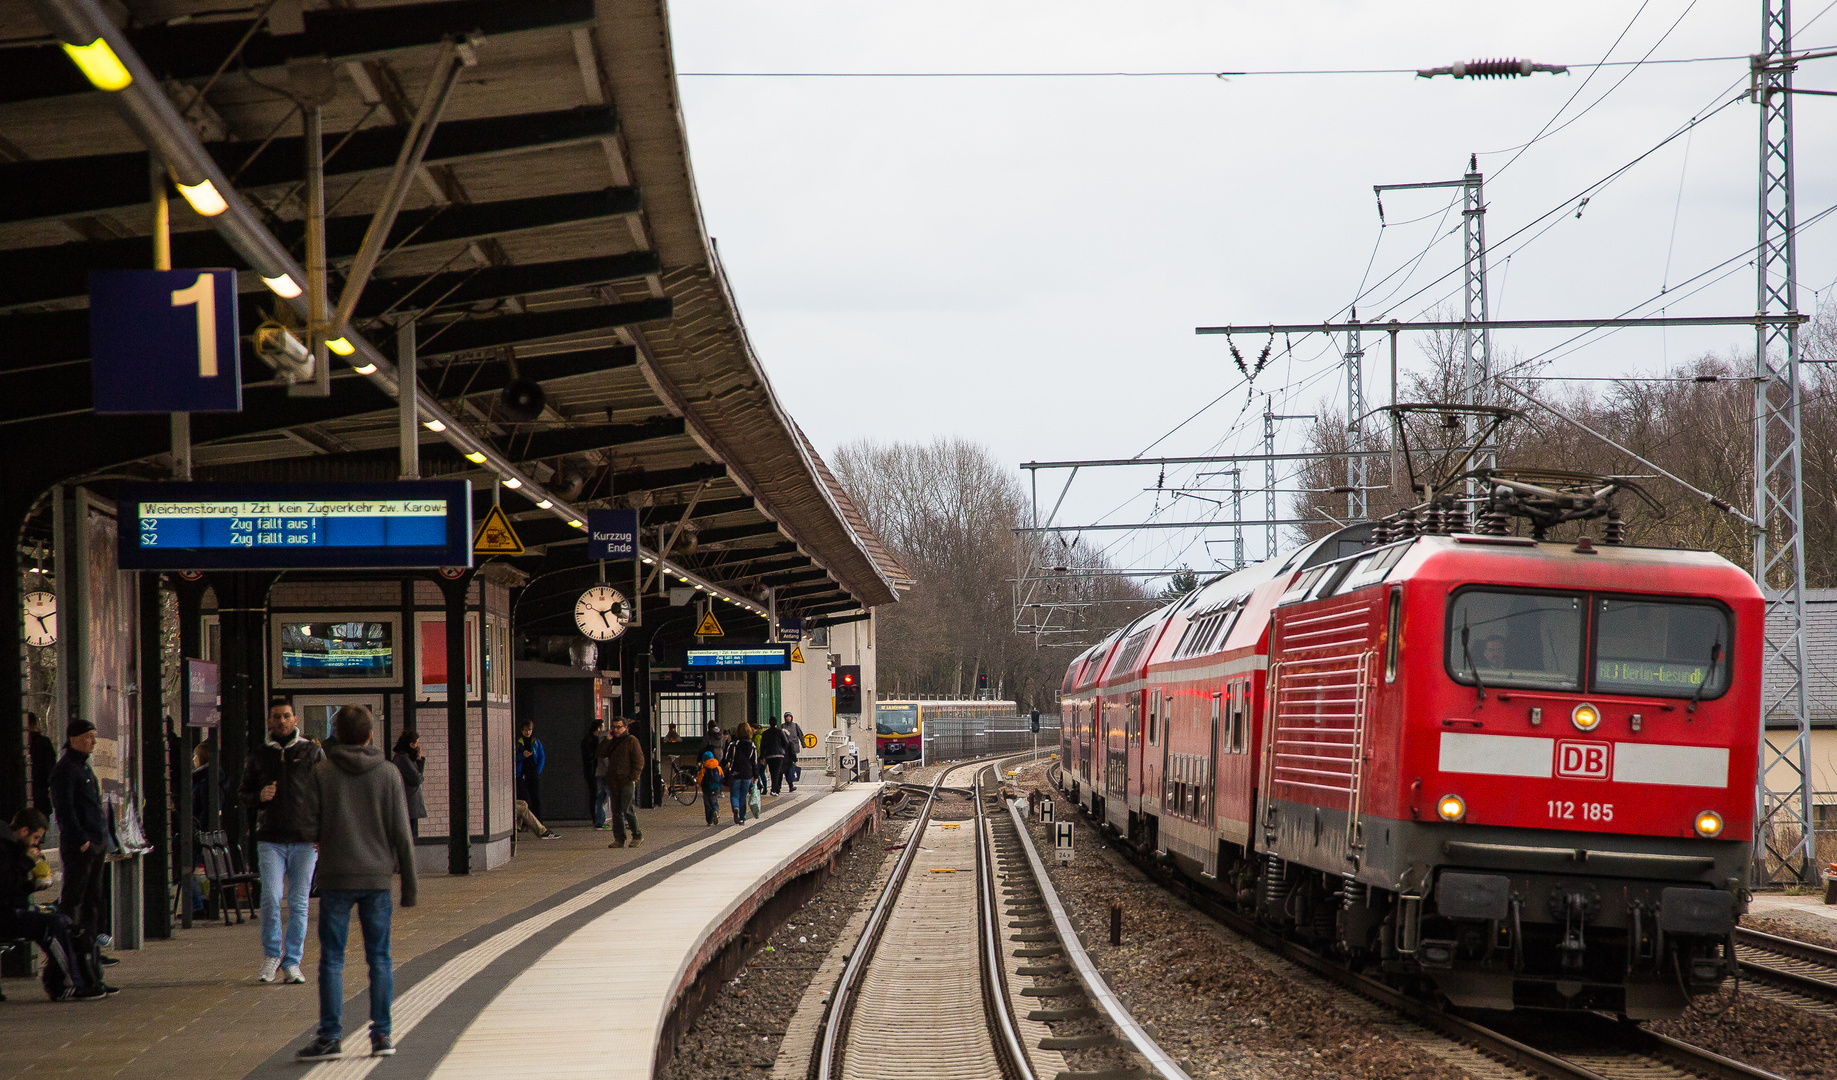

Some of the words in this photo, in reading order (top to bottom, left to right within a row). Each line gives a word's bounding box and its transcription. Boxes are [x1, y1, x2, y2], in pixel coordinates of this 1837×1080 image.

[170, 273, 218, 377] 1
[144, 502, 238, 516] Weichenstörung
[279, 502, 302, 513] kein
[307, 502, 373, 516] Zugverkehr
[379, 504, 399, 513] zw.
[140, 518, 158, 531] S2
[230, 518, 253, 532] Zug
[257, 518, 283, 530] fällt
[287, 520, 308, 529] aus
[140, 533, 158, 545] S2
[230, 533, 253, 547] Zug
[257, 532, 283, 544] fällt
[287, 534, 308, 544] aus
[593, 531, 632, 542] Kurzzug
[607, 543, 632, 553] Ende
[1563, 746, 1603, 773] DB
[1041, 802, 1054, 821] H
[1547, 800, 1575, 819] 112
[1582, 802, 1614, 822] 185
[1057, 824, 1072, 847] H
